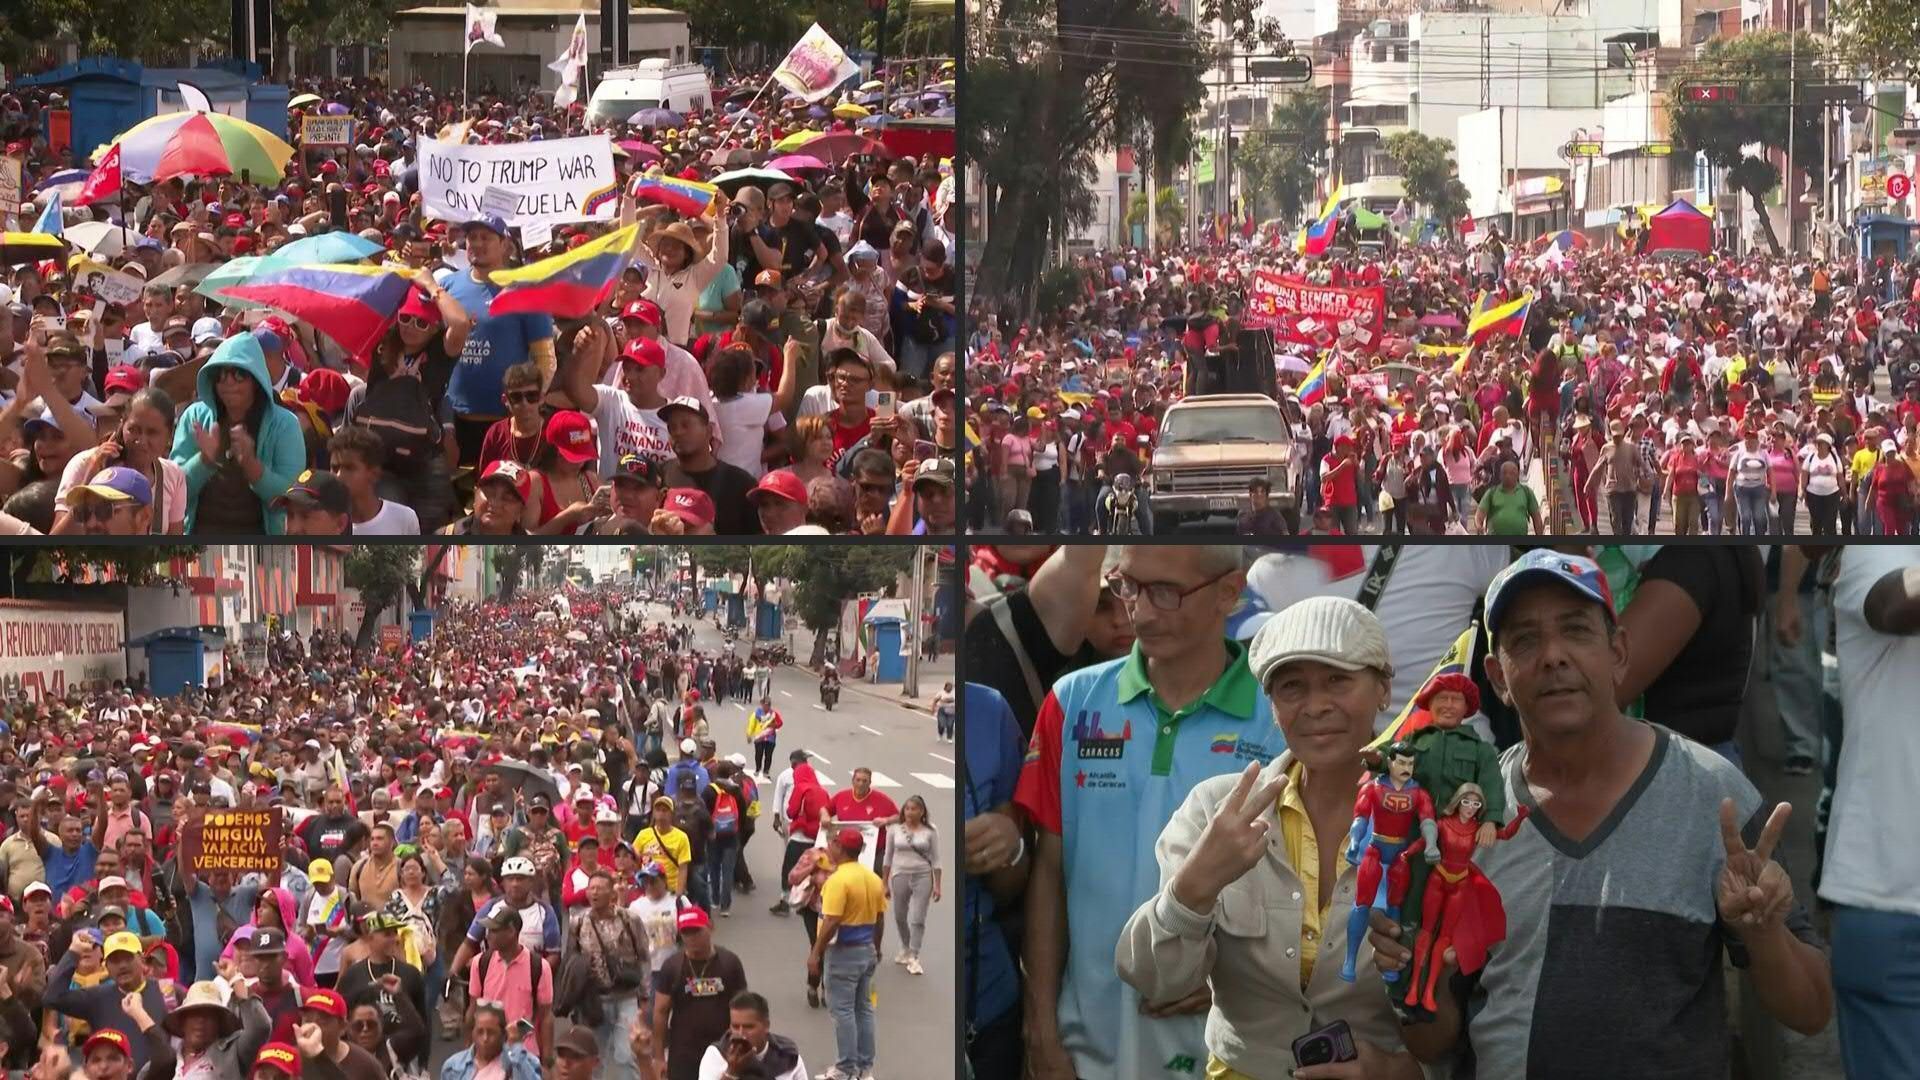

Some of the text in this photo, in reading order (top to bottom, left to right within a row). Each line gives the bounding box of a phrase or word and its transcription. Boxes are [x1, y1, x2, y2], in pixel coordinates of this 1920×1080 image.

[429, 153, 597, 185] NO TO TRUMP WAR
[445, 188, 468, 210] ON
[471, 191, 578, 217] VZUELA
[1300, 289, 1349, 309] RENACER
[5, 620, 73, 657] REVOLUCIONARIO
[74, 622, 84, 656] DE
[85, 622, 121, 655] VENEZUELA
[1080, 746, 1121, 758] CARACAS
[203, 812, 272, 827] PODEMOS
[202, 827, 265, 843] NIRGUA
[201, 841, 268, 855] YARACUY
[193, 855, 279, 870] VENCEREMOS
